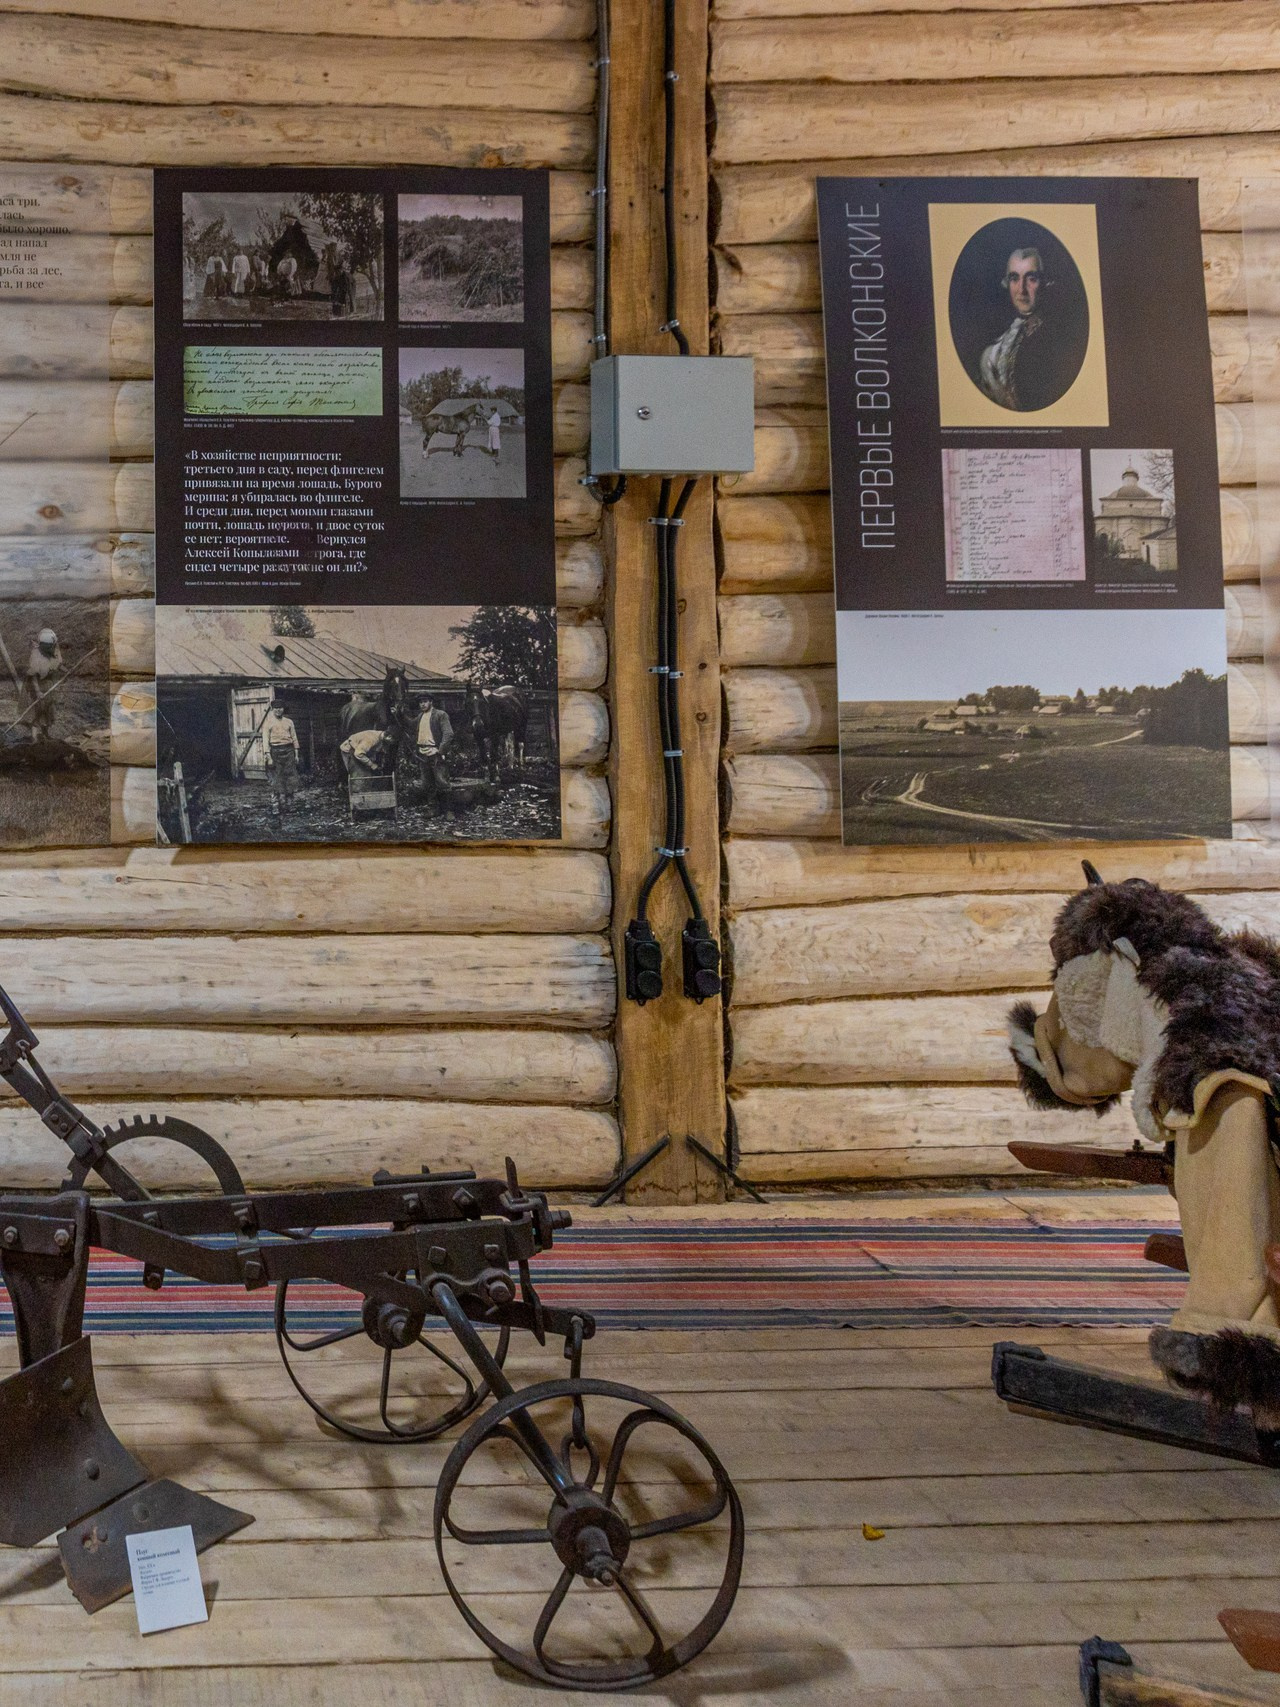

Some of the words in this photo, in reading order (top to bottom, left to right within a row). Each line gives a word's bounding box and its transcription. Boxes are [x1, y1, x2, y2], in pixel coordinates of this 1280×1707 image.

[14, 239, 49, 248] напал
[23, 253, 37, 262] не
[26, 267, 38, 276] за
[15, 280, 23, 289] и
[25, 280, 44, 289] все
[845, 202, 891, 410] ВОЛКОНСКИЕ
[184, 449, 198, 460] «В
[200, 449, 256, 461] хозяйстве
[183, 466, 234, 477] третьего
[235, 466, 255, 477] дня
[258, 466, 265, 475] в
[296, 466, 328, 477] перед
[329, 464, 385, 477] флигелем
[183, 480, 243, 491] привязали
[245, 480, 259, 489] на
[261, 480, 295, 491] время
[344, 478, 382, 491] Бурого
[857, 420, 896, 549] ПЕРВЫЕ
[231, 494, 238, 502] я
[240, 492, 297, 505] убиралась
[299, 494, 313, 502] во
[184, 505, 193, 516] И
[195, 507, 228, 518] среди
[255, 507, 287, 519] перед
[290, 507, 327, 516] моими
[330, 507, 374, 516] глазами
[223, 521, 265, 533] лошадь
[315, 521, 323, 530] и
[325, 521, 351, 533] двое
[352, 521, 385, 533] суток
[184, 535, 197, 544] ее
[317, 533, 367, 546] Вернулся
[184, 547, 230, 558] Алексей
[348, 550, 367, 561] где
[184, 563, 216, 575] сидел
[218, 564, 259, 575] четыре
[325, 564, 340, 572] он
[342, 562, 368, 572] ли?»
